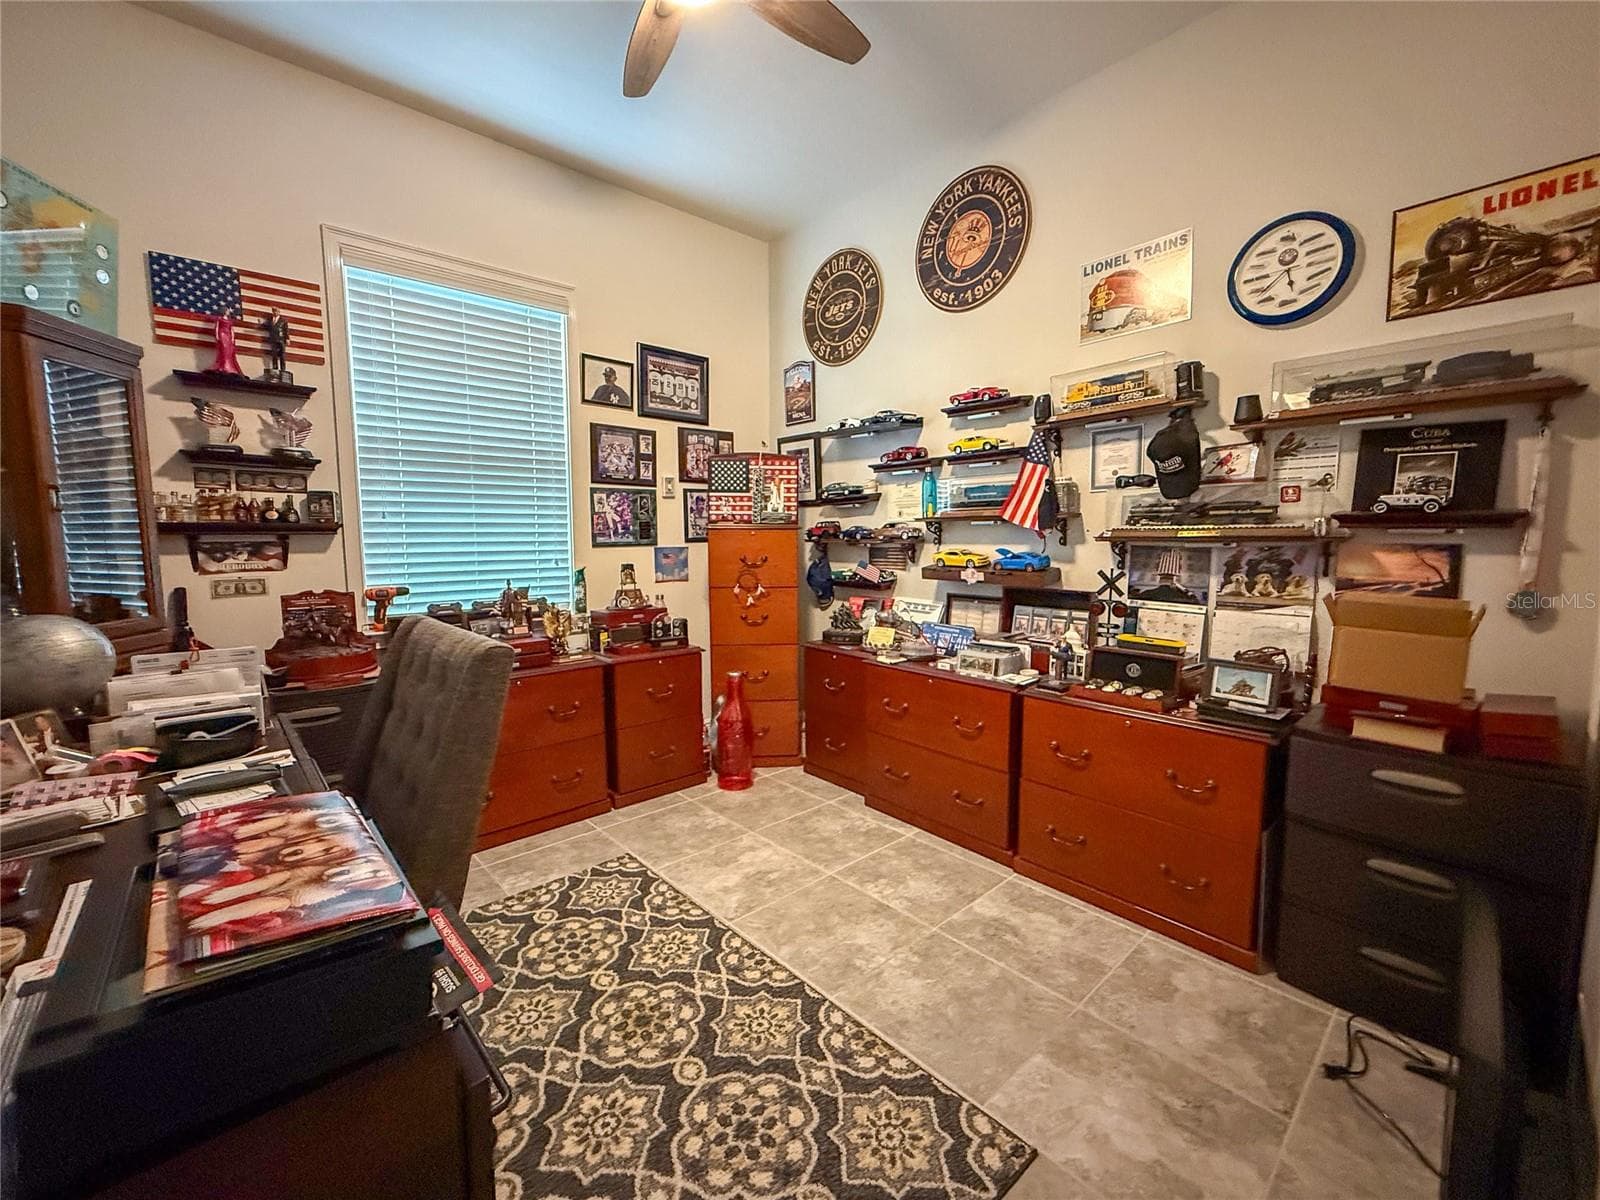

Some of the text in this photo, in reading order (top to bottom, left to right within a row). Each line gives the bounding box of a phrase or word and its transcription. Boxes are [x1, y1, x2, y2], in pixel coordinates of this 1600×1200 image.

[1483, 169, 1598, 215] LIONEL
[921, 220, 939, 260] NEW
[936, 178, 973, 219] YORK
[976, 172, 1023, 229] YANKEES
[1083, 254, 1130, 277] LIONEL
[1134, 233, 1189, 261] TRAINS
[807, 253, 877, 310] NEW YORK JETS
[932, 267, 1004, 306] est. 1903
[824, 298, 853, 317] JETS
[812, 324, 869, 361] est. 1960
[437, 974, 457, 993] SUSHI
